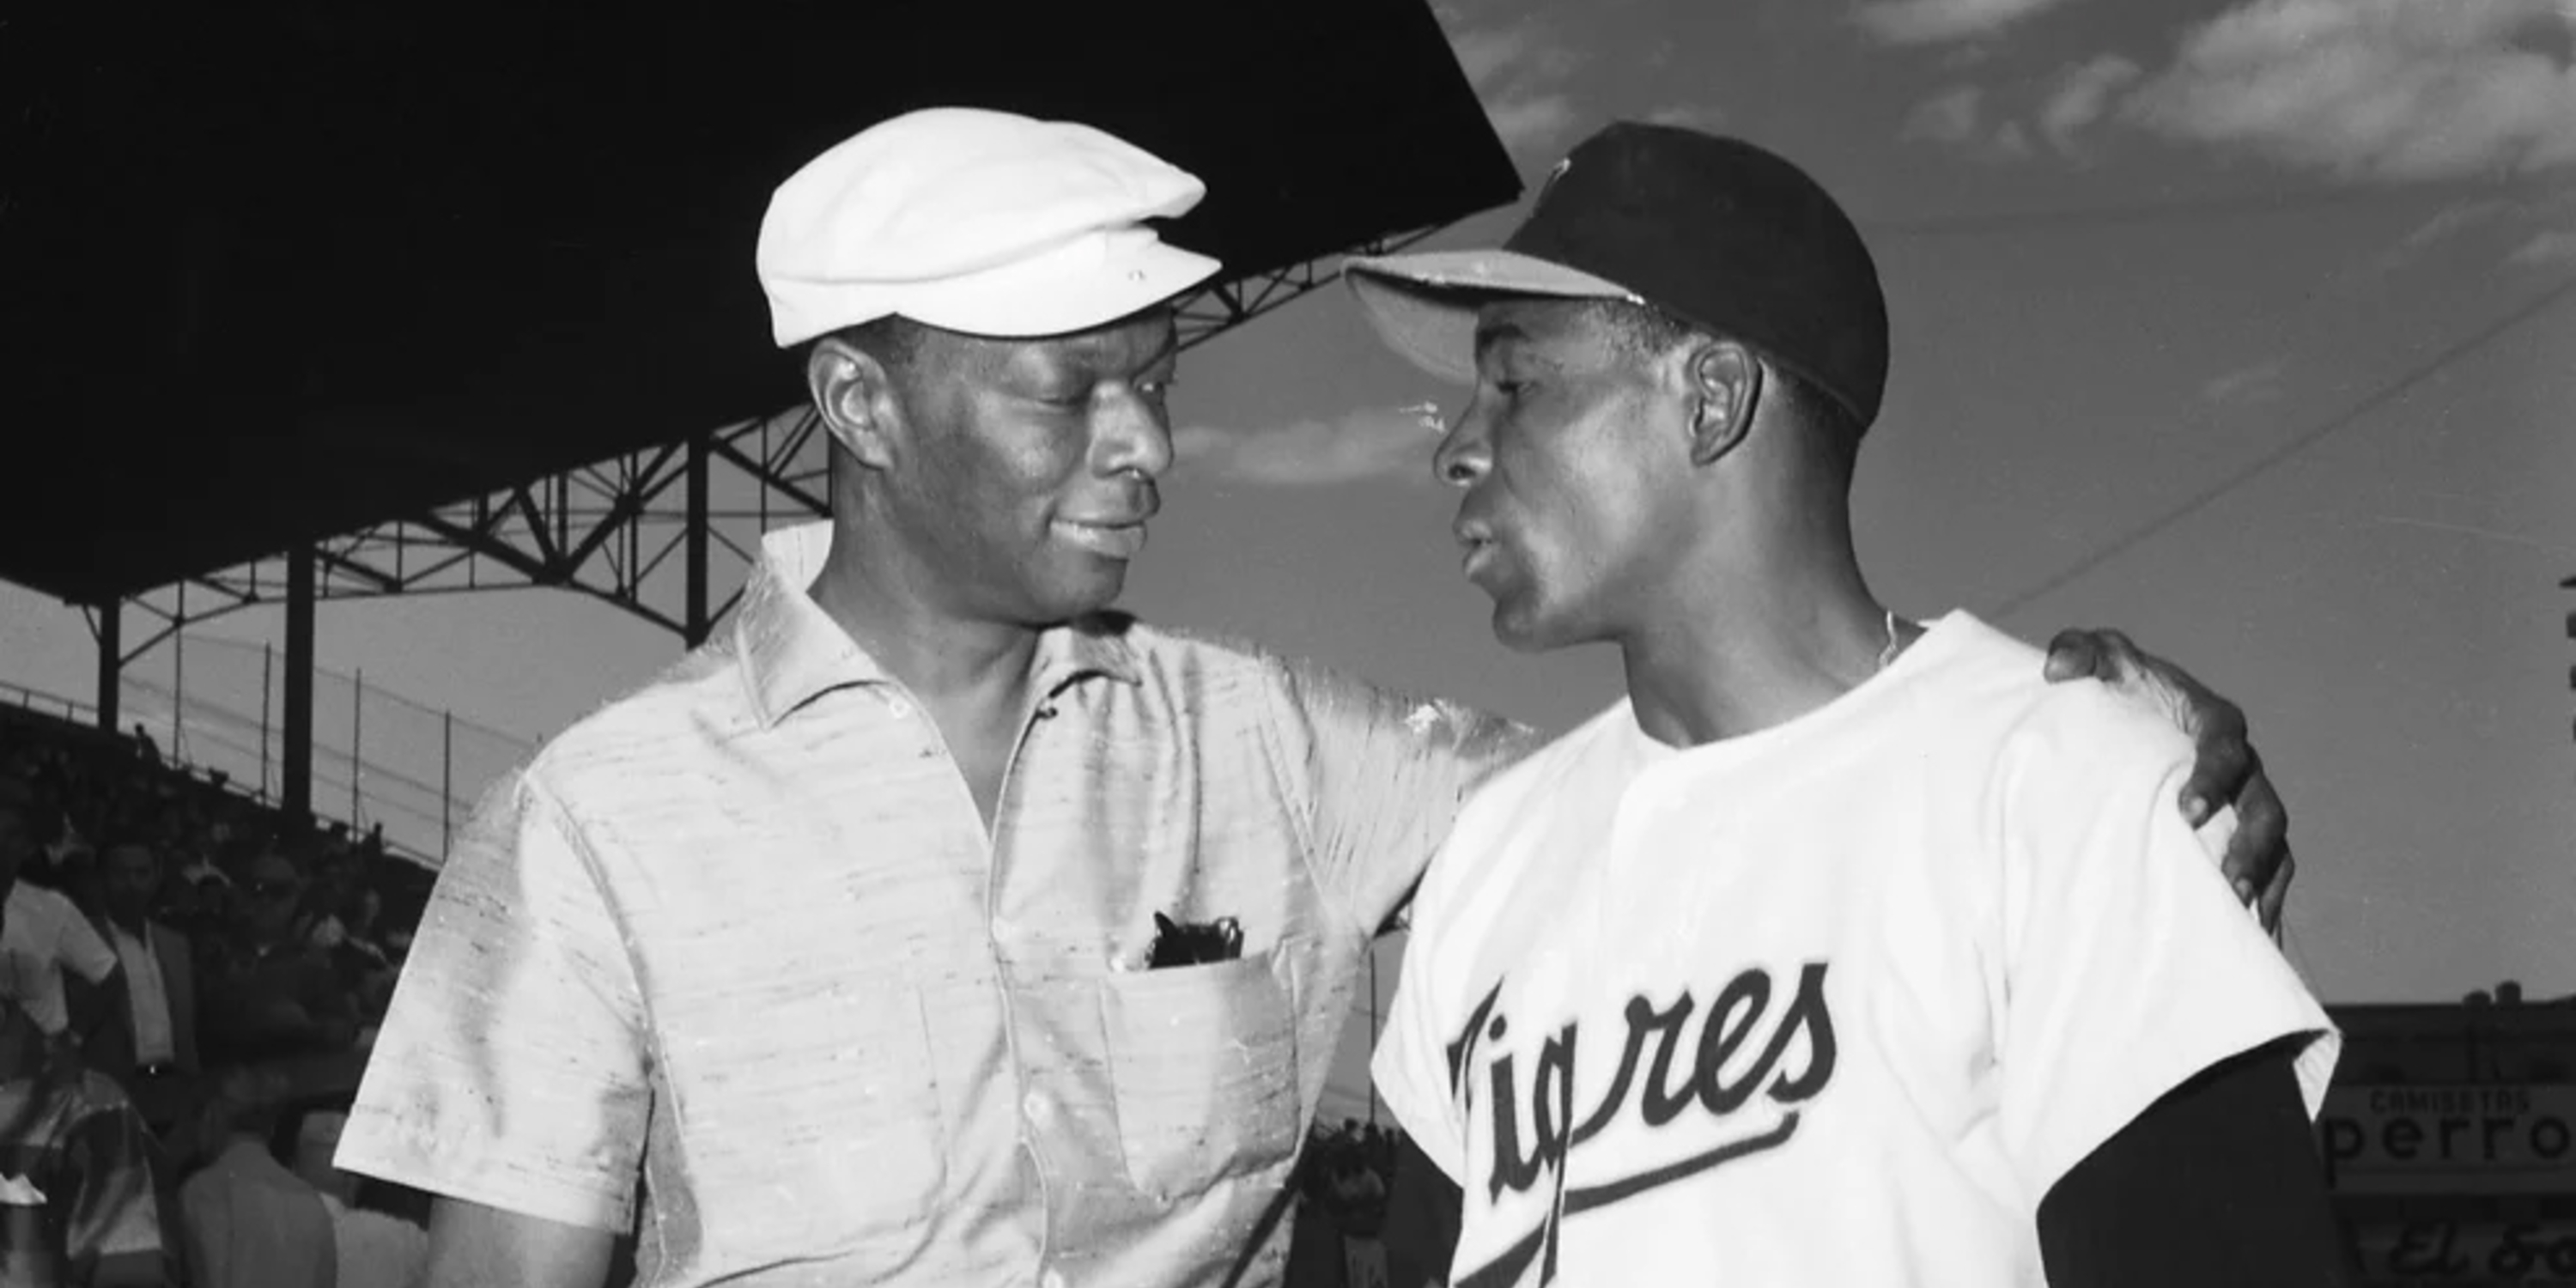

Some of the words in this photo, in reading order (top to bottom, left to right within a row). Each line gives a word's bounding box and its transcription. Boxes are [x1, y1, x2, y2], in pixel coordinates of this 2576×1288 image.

[2369, 1088, 2530, 1115] CAMISETAS
[2322, 1117, 2572, 1190] perro
[2388, 1218, 2470, 1275] El
